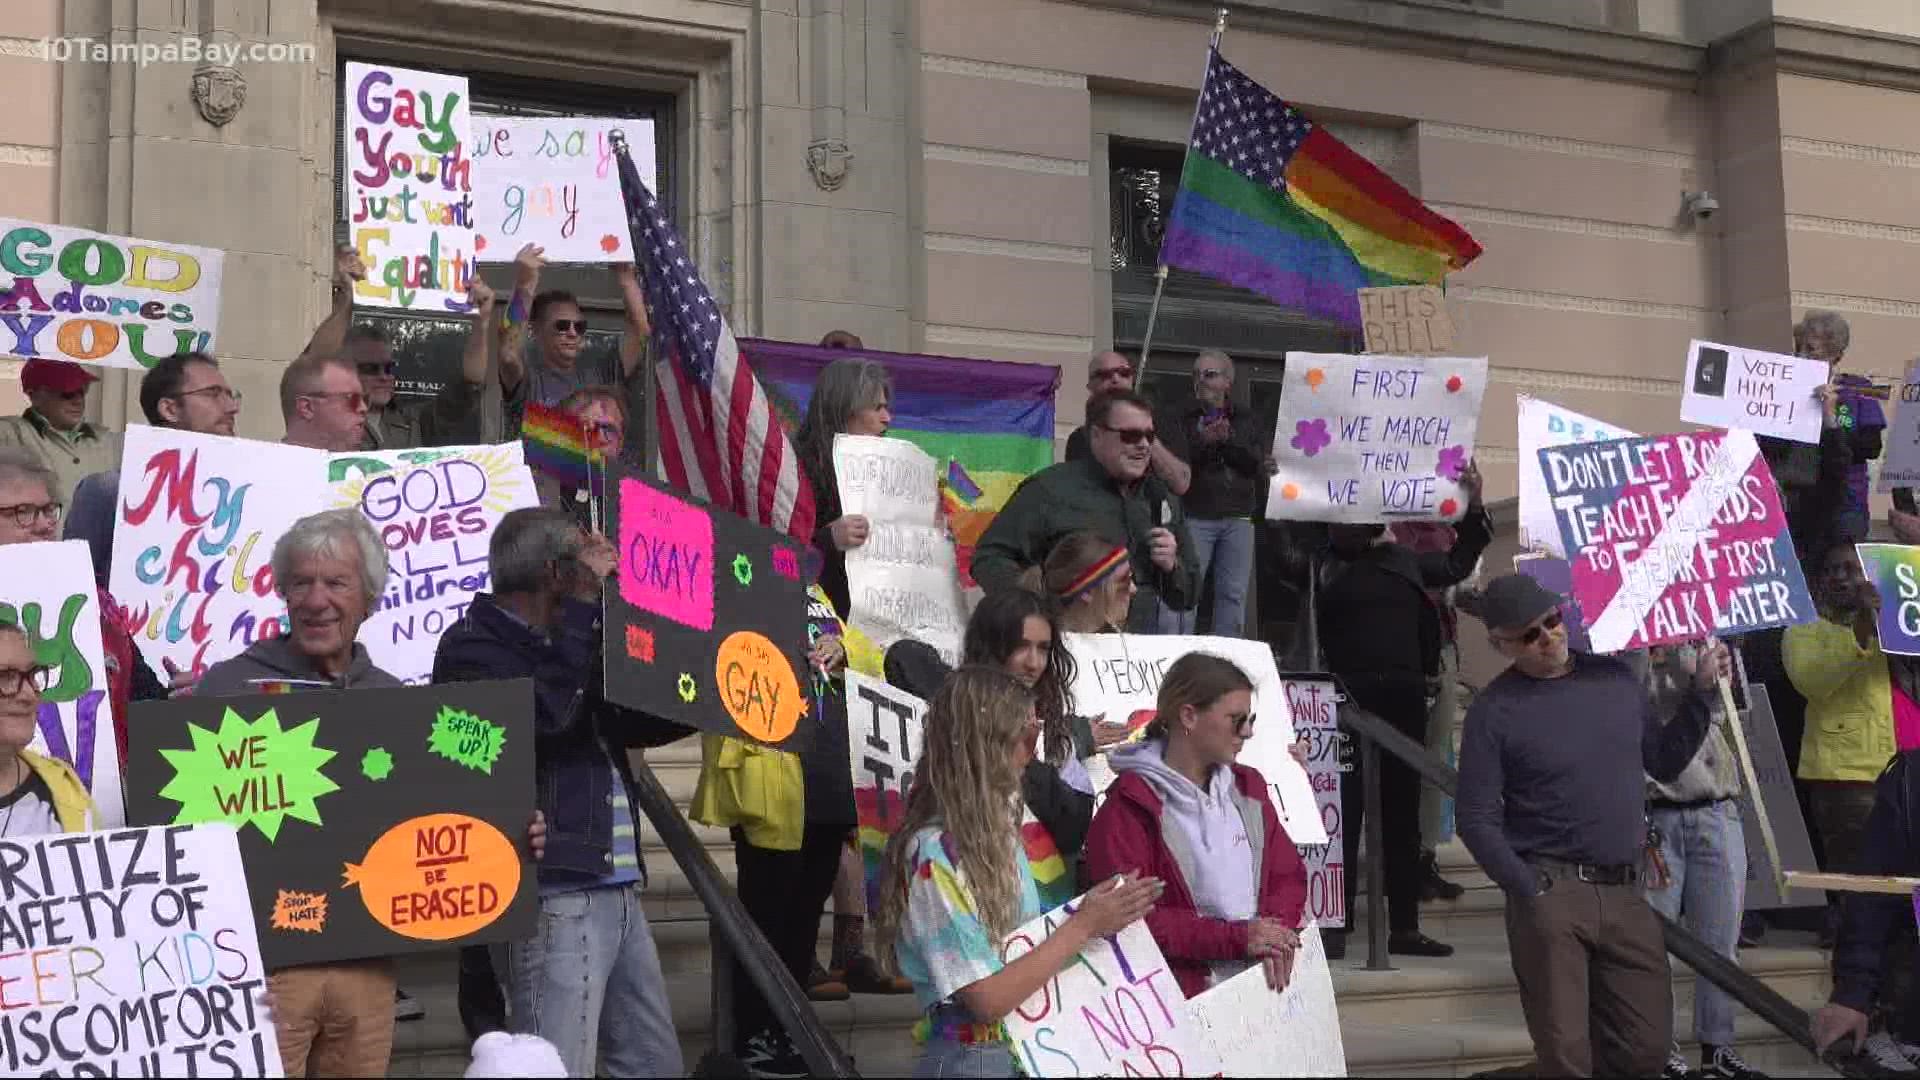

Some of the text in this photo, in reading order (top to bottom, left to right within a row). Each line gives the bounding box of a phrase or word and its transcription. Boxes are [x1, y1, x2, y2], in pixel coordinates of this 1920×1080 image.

[357, 71, 460, 154] Gay
[353, 127, 472, 193] Youth
[353, 184, 474, 229] just want
[502, 185, 579, 239] gay
[0, 227, 201, 292] GOD
[355, 228, 477, 311] Equality
[0, 278, 194, 323] Adores
[1361, 290, 1437, 319] THIS
[1365, 320, 1445, 353] BILL
[1352, 369, 1424, 400] FIRST
[1738, 379, 1774, 400] HIM
[1743, 354, 1793, 381] VOTE
[1340, 416, 1451, 447] WE MARCH
[1362, 451, 1410, 473] THEN
[1620, 442, 1673, 486] LET
[123, 447, 253, 556] My
[361, 460, 487, 522] GOD
[1327, 478, 1436, 511] WE VOTE
[381, 506, 487, 550] OVES
[1554, 494, 1658, 546] TEACH
[388, 540, 490, 578] LL
[630, 533, 701, 603] OKAY
[1582, 545, 1612, 572] TO
[1703, 580, 1798, 628] LATER
[726, 662, 780, 734] GAY
[446, 717, 492, 738] SPEAK
[216, 735, 269, 770] WE
[213, 773, 296, 817] WILL
[416, 822, 473, 858] NOT
[424, 868, 447, 885] BE
[151, 885, 208, 931] OF
[289, 907, 320, 922] HATE
[390, 882, 499, 925] ERASED
[134, 928, 248, 992] KIDS
[0, 979, 263, 1072] ISCOMFORT
[1080, 968, 1175, 1062] NOT
